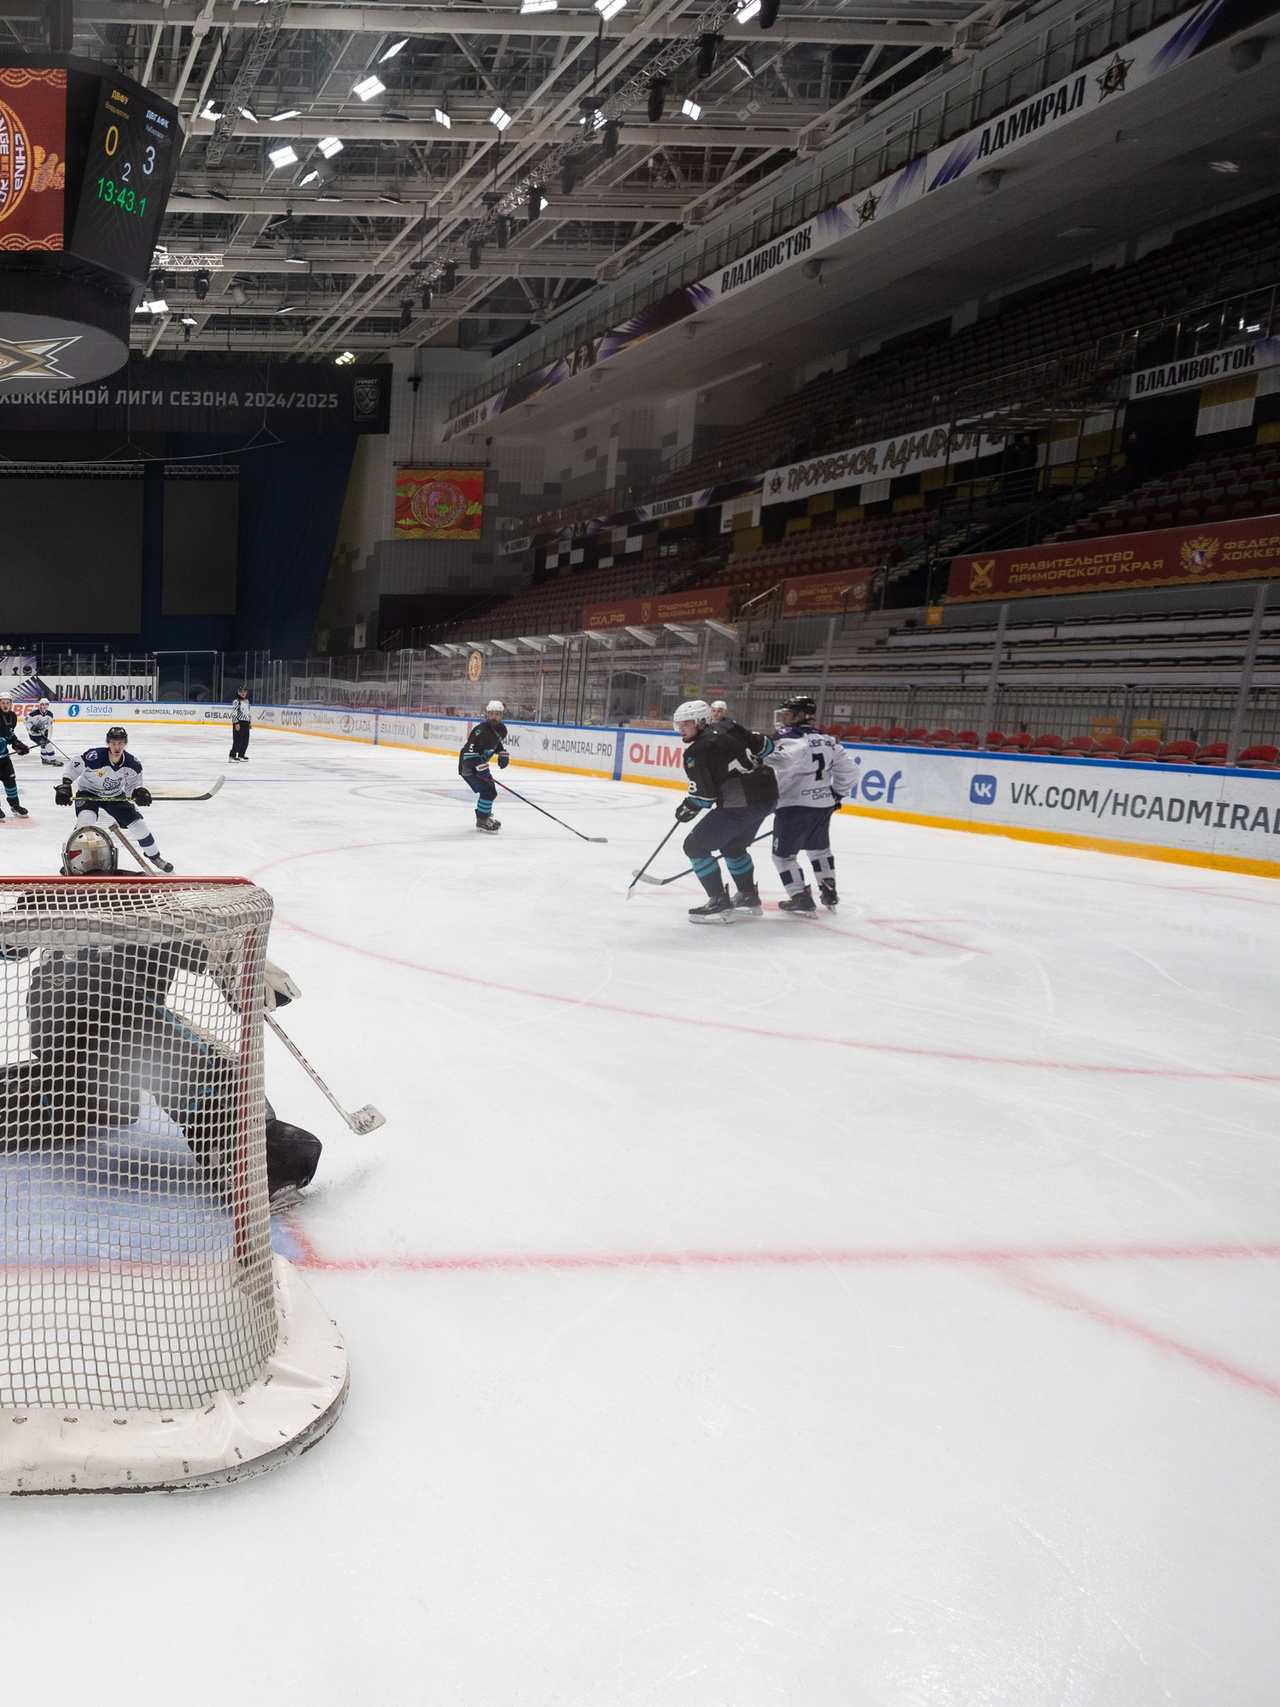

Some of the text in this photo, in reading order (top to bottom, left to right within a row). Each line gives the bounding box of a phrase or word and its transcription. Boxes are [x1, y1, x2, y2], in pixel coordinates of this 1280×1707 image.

[977, 74, 1087, 160] АДМИРАЛ
[105, 125, 119, 156] 0
[142, 145, 155, 175] 3
[122, 163, 131, 182] 2
[98, 177, 147, 217] 13:43.1
[721, 225, 812, 294] ВЛАДИВОСТОК
[1135, 345, 1256, 394] ВЛАДИВОСТОК
[115, 389, 164, 405] ЛИГИ
[170, 391, 239, 407] СЕЗОНА
[244, 392, 338, 408] 2024/2025
[1223, 537, 1280, 550] ФЕДЕР
[1008, 559, 1164, 583] ПРИМОРСКОГО КРАЯ
[1010, 551, 1134, 573] ПРАВИТЕЛЬСТВО
[590, 614, 625, 626] СХЛ.РФ
[55, 684, 152, 702] ВЛАДИВОСТОК
[86, 705, 113, 714] slavda
[503, 736, 520, 747] АНК
[551, 739, 613, 757] HCADMIRAL.PRO
[629, 743, 686, 769] OLIM
